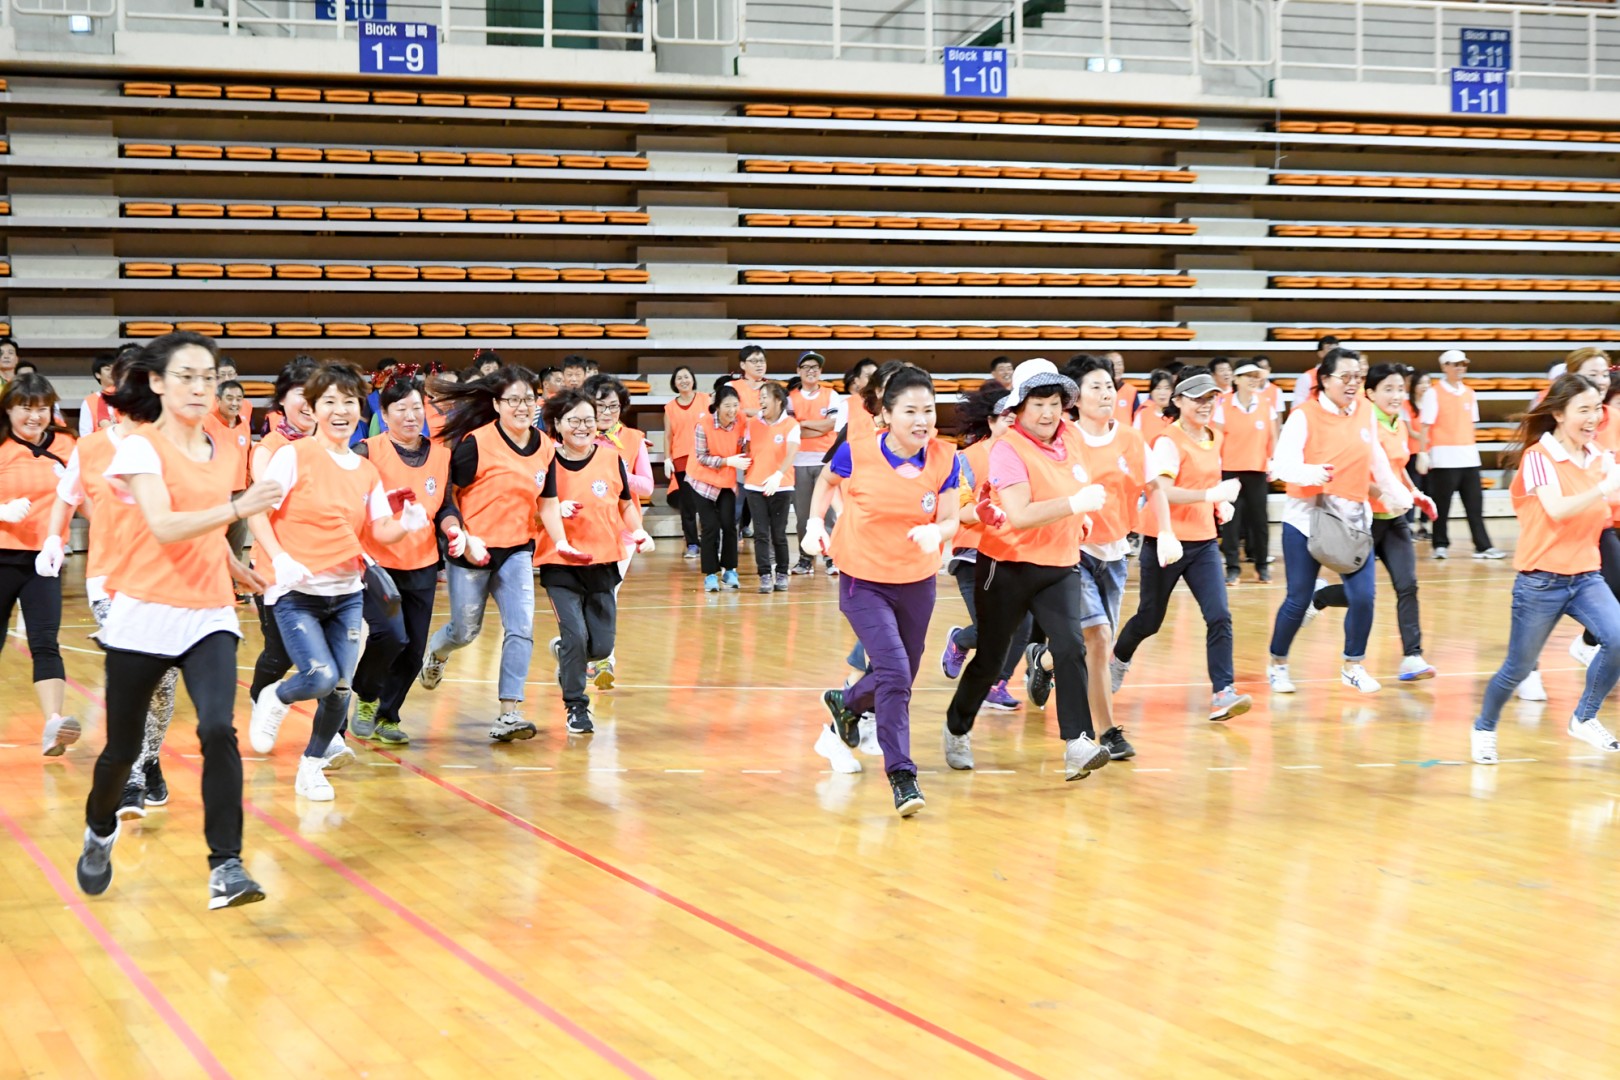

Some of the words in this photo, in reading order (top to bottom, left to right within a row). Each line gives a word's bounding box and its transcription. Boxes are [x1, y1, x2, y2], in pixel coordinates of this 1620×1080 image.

[365, 23, 397, 36] Block
[371, 42, 424, 72] 1-9
[949, 49, 977, 61] Block
[952, 66, 1002, 94] 1-10
[1459, 87, 1499, 113] 1-11
